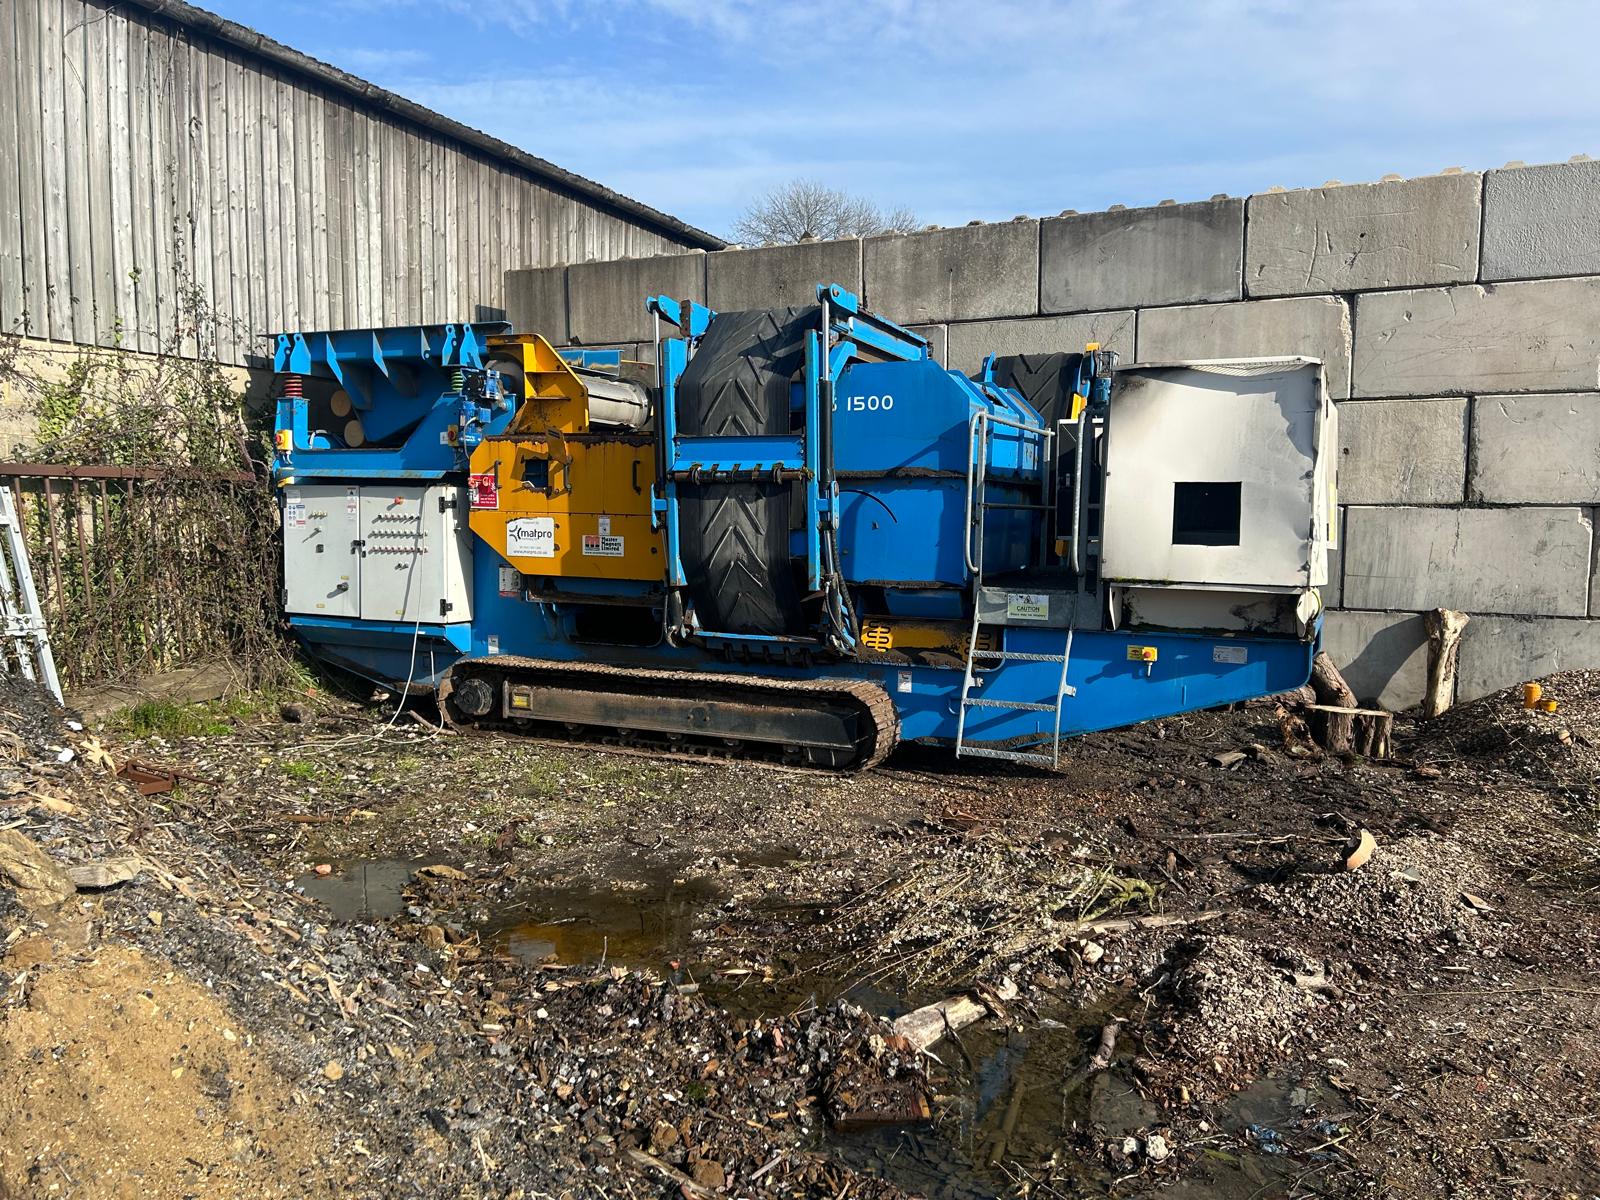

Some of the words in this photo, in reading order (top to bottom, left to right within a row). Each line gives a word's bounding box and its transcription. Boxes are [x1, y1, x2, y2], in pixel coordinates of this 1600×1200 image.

[847, 395, 894, 411] 1500
[520, 529, 552, 540] matpro
[1016, 605, 1040, 613] CAUTION
